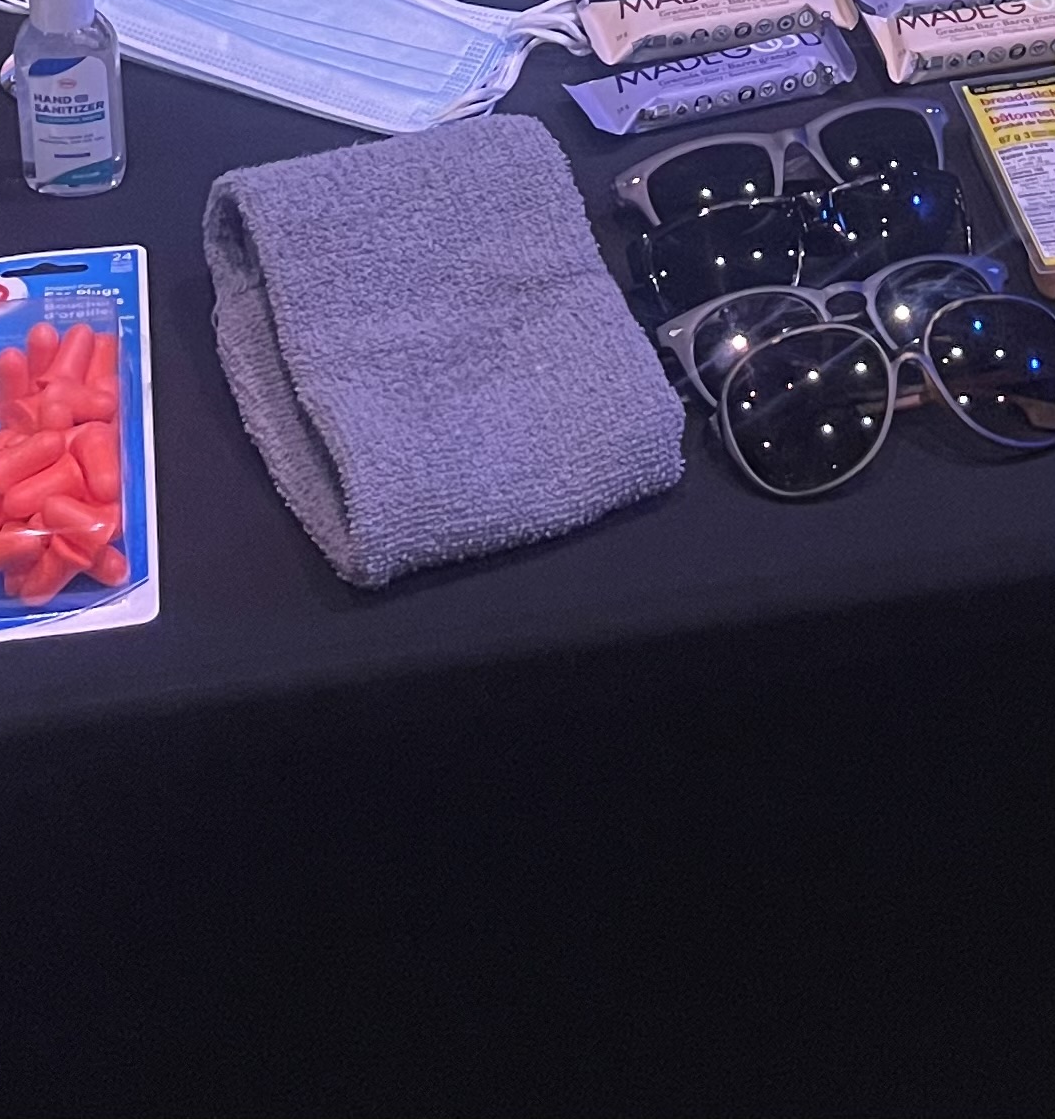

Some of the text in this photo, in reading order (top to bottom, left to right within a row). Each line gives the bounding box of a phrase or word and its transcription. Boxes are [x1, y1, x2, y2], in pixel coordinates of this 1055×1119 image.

[33, 93, 72, 105] HAND
[980, 89, 1055, 106] breadstick
[34, 101, 105, 115] SANITIZER
[988, 108, 1055, 125] bâtonnet
[112, 252, 132, 262] 24
